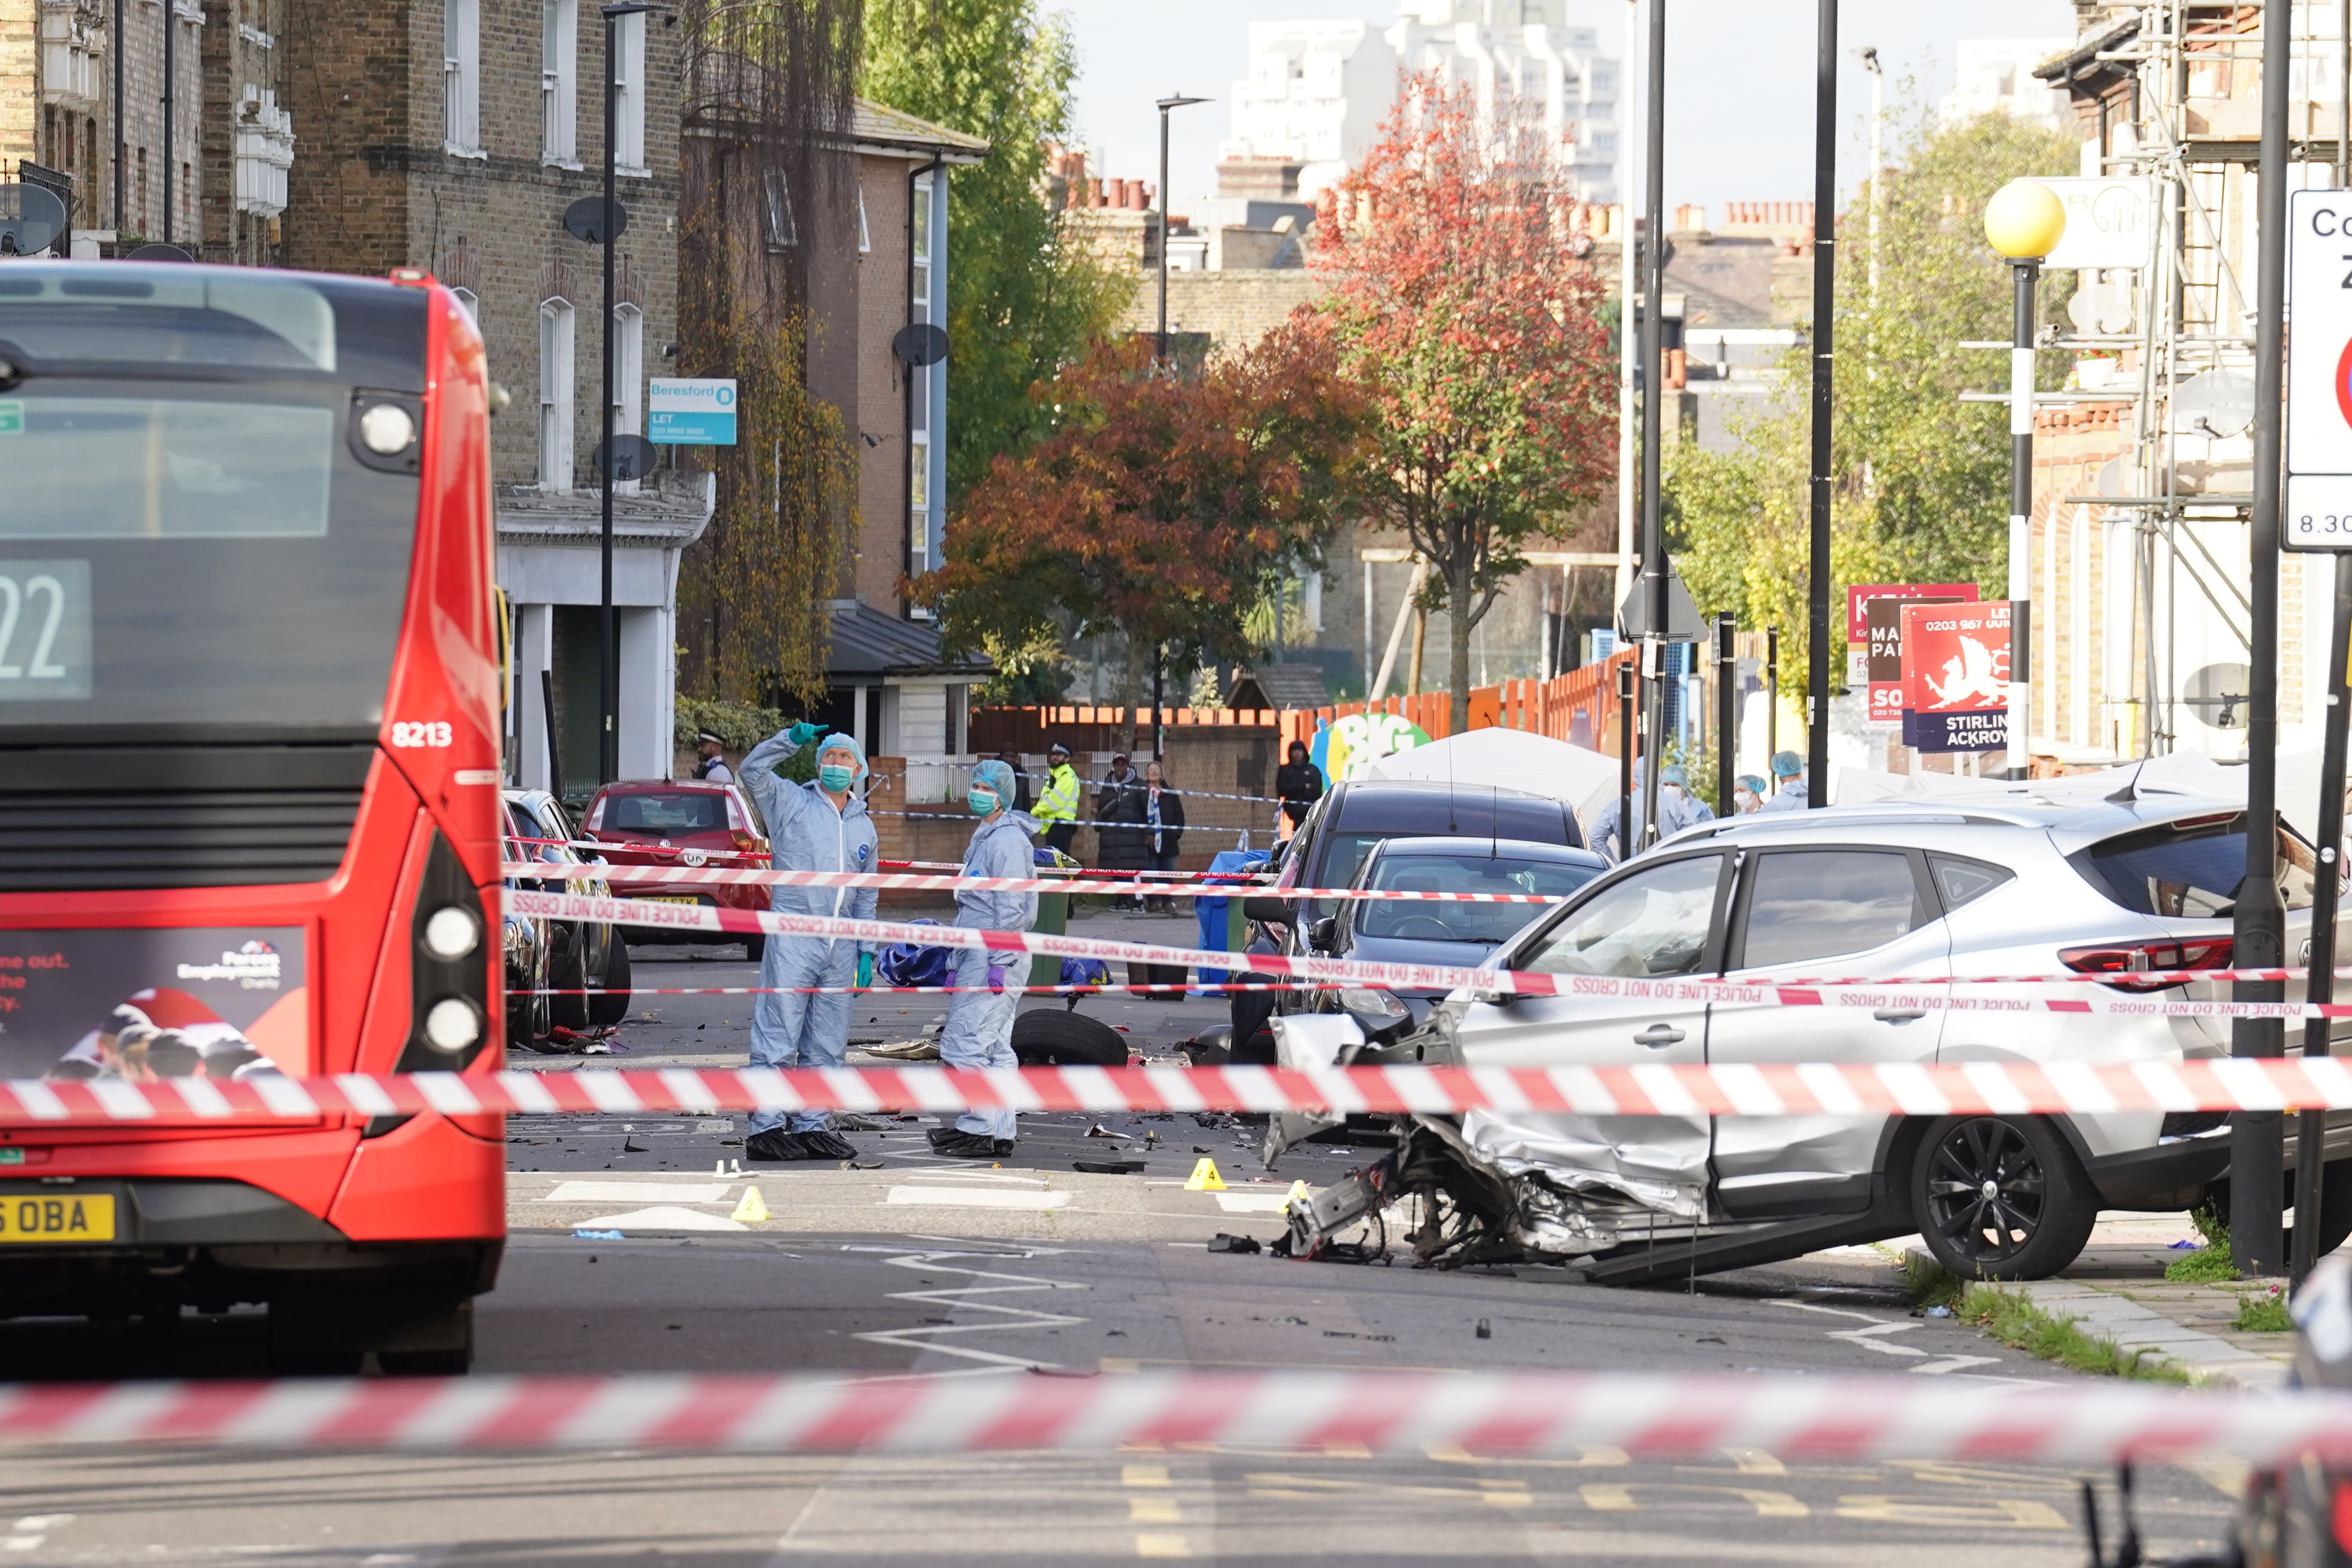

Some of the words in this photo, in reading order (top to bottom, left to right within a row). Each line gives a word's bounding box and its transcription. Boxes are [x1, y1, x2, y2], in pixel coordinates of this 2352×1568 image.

[651, 384, 714, 396] Beresford
[653, 414, 673, 424] LET
[2301, 515, 2352, 533] 8.30
[1925, 620, 1956, 631] 0203
[1873, 688, 1903, 708] SO
[1946, 714, 2008, 730] STIRLIN
[391, 721, 453, 748] 8213
[1334, 715, 1414, 764] BIG
[1947, 730, 2008, 746] ACKROY
[513, 894, 558, 914] CROSS
[564, 899, 590, 916] NOT
[598, 902, 614, 918] DO
[620, 904, 648, 921] LINE
[654, 906, 701, 924] POLICE
[778, 917, 823, 935] CROSS
[829, 920, 855, 936] NOT
[861, 924, 878, 938] DO
[884, 926, 912, 940] LINE
[918, 929, 964, 943] POLICE
[1043, 939, 1088, 953] CROSS
[1094, 946, 1119, 956] NOT
[27, 952, 70, 969] out.
[1308, 960, 1353, 976] CROSS
[177, 963, 280, 981] Employment
[1358, 962, 1383, 979] NOT
[1389, 964, 1407, 981] DO
[1415, 967, 1442, 984] LINE
[1447, 969, 1494, 987] POLICE
[1573, 976, 1618, 995] CROSS
[1623, 981, 1650, 996] NOT
[1655, 983, 1673, 997] DO
[1679, 984, 1708, 1000] LINE
[1714, 987, 1761, 1002] POLICE
[1839, 994, 1885, 1006] CROSS
[1890, 996, 1918, 1007] NOT
[1923, 997, 1941, 1008] DO
[1947, 999, 1976, 1009] LINE
[1982, 1000, 2030, 1010] POLICE
[2109, 1003, 2155, 1012] CROSS
[2161, 1004, 2187, 1013] NOT
[2194, 1004, 2212, 1013] DO
[2217, 1004, 2248, 1014] LINE
[2253, 1004, 2301, 1014] POLICE
[1209, 1170, 1215, 1181] 4
[746, 1199, 754, 1211] 2
[19, 1200, 88, 1233] OBA
